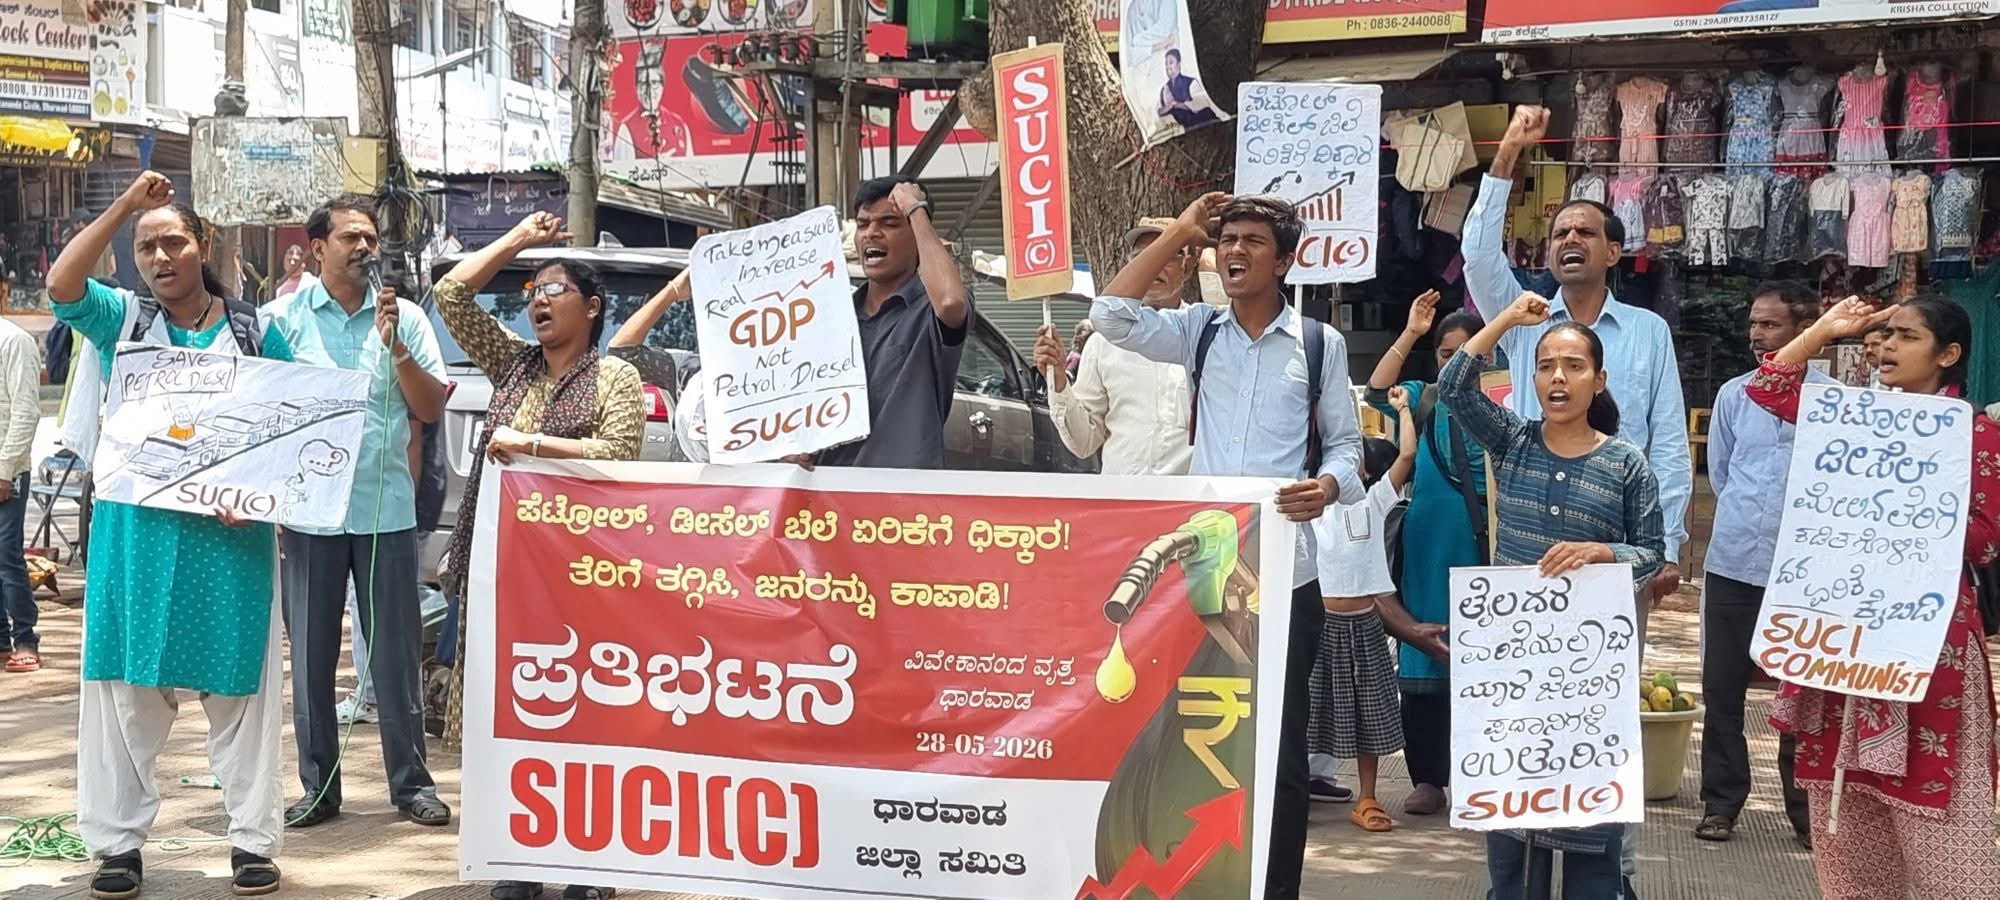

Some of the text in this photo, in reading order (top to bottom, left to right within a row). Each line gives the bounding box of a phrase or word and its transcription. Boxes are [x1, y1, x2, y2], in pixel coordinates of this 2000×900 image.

[1346, 19, 1362, 31] Ph
[1369, 14, 1451, 30] 0836-2440088
[1890, 1, 1989, 14] KRISHA COLLECTION
[36, 21, 87, 51] Center
[704, 283, 747, 320] Real
[729, 297, 816, 348] GDP
[151, 351, 210, 369] SAVE
[755, 346, 793, 370] Not
[789, 335, 858, 392] Diesel
[516, 492, 1071, 565] ಪೆಟ್ರೋಲ್, ಡೀಸೆಲ್ ಬೆಲೆ ಏರಿಕೆಗೆ ಧಿಕ್ಕಾರ!
[568, 554, 1010, 620] ತೆರಿಗೆ ತಗ್ಗಿಸಿ, ಜನರನ್ನು ಕಾಪಾಡಿ!
[1762, 612, 1864, 659] SUCI
[510, 623, 858, 731] ಪ್ರತಿಭಟನೆ
[904, 649, 1077, 686] ವಿವೇಕಾನಂದ ವೃತ್ತ
[938, 687, 1035, 711] ಧಾರವಾಡ
[916, 731, 1054, 760] 28-05-2026
[509, 757, 821, 868] SUCI(C)
[873, 796, 1008, 827] ಧಾರವಾಡ
[855, 845, 1027, 880] ಜಿಲ್ಲಾ ಸಮಿತಿ
